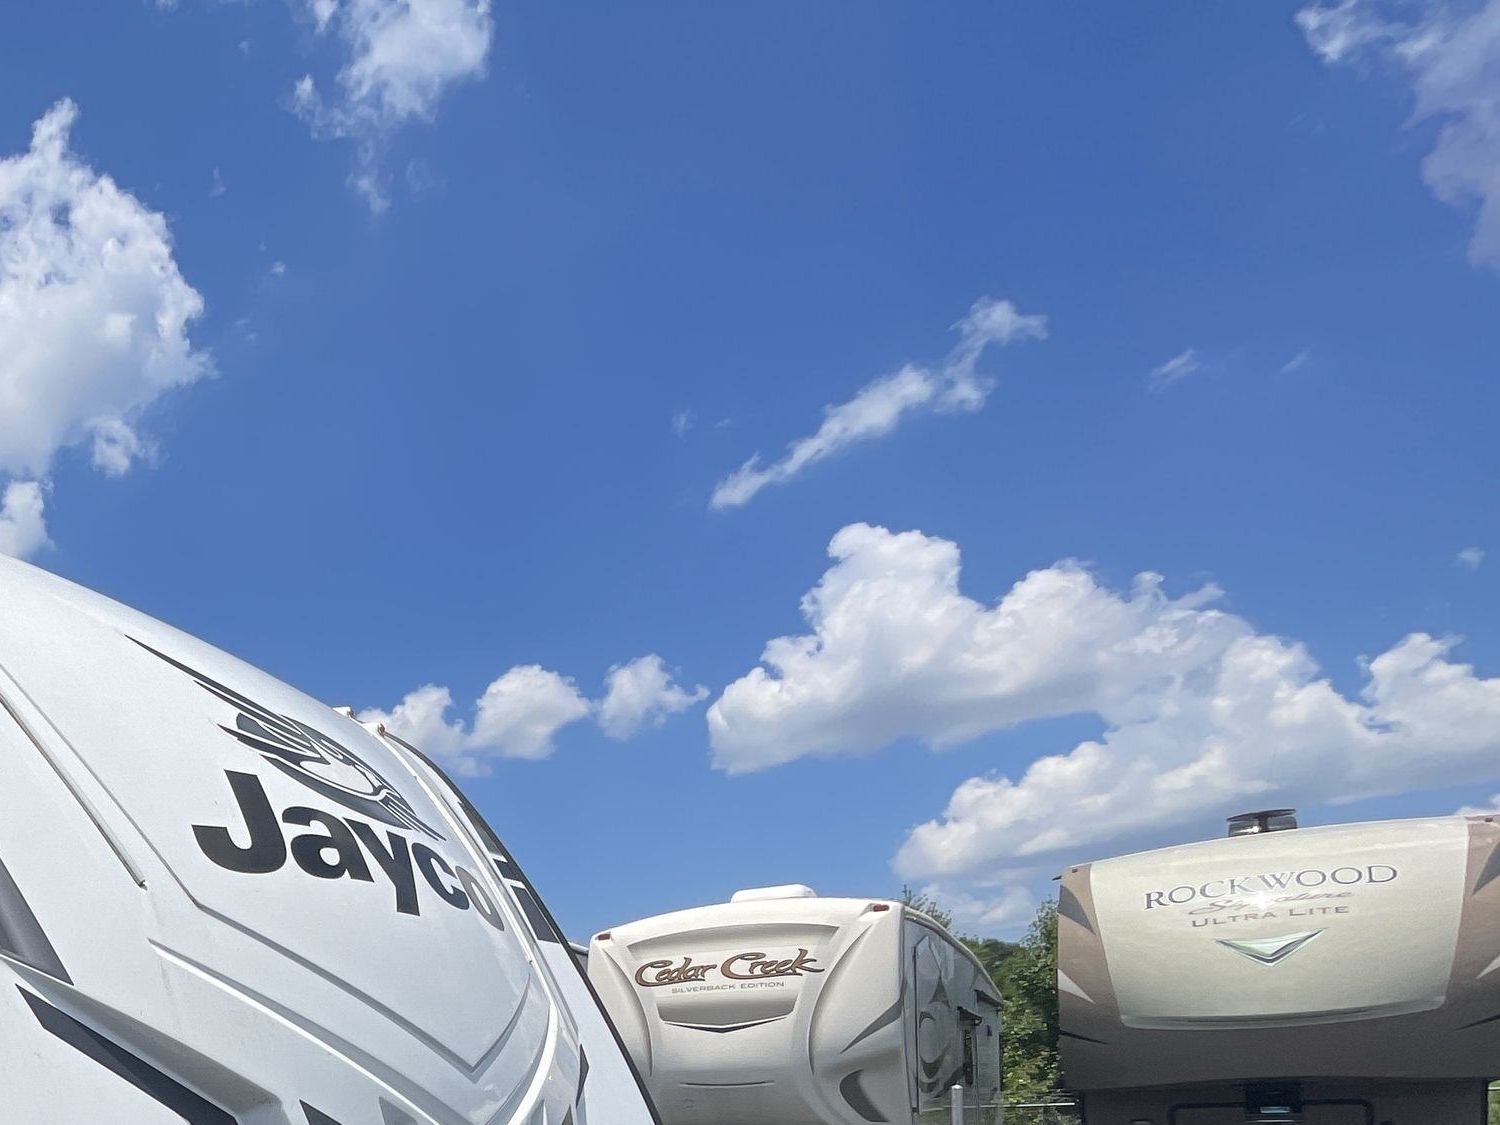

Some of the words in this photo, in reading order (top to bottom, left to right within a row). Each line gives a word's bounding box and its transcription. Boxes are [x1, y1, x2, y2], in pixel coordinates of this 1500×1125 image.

[191, 769, 504, 931] Jayco
[1144, 864, 1398, 910] ROCKWOOD
[1192, 911, 1277, 928] ULTRA
[1288, 906, 1349, 916] LITE
[634, 957, 717, 987] Cedar
[720, 949, 825, 980] Creek
[671, 984, 736, 994] SILVERBACK
[740, 981, 785, 990] EDITION
